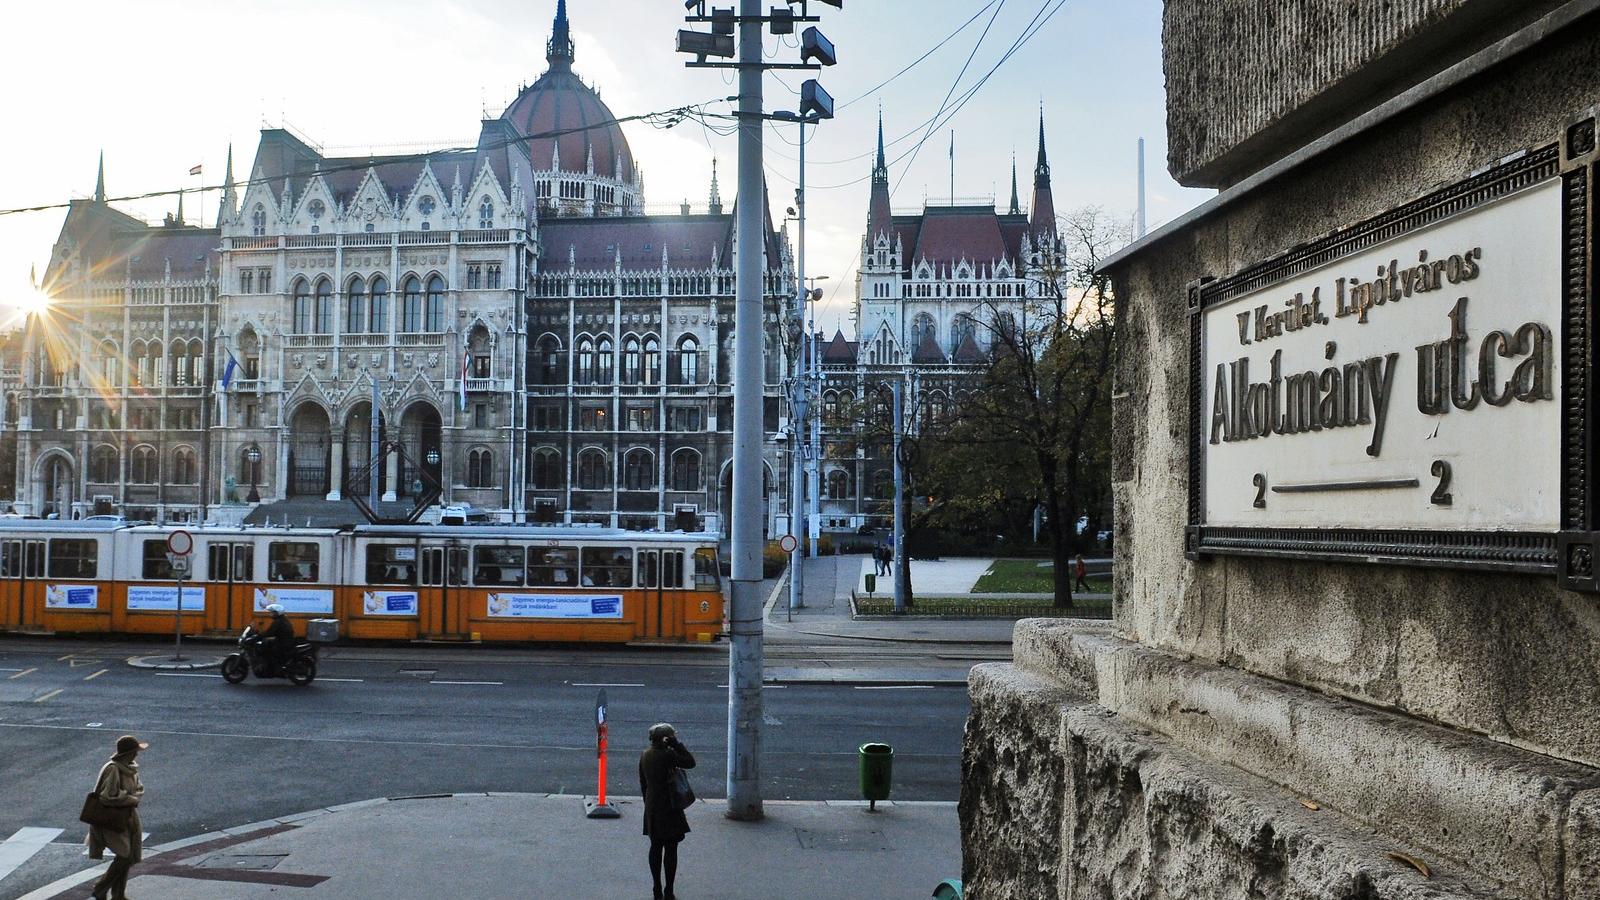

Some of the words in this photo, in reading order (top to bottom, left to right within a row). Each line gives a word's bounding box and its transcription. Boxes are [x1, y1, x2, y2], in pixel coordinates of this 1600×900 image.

[1335, 247, 1482, 324] Lipótváros
[1209, 341, 1400, 458] Alkotmány
[1415, 296, 1554, 416] utca
[1252, 472, 1268, 509] 2
[1430, 459, 1453, 506] 2
